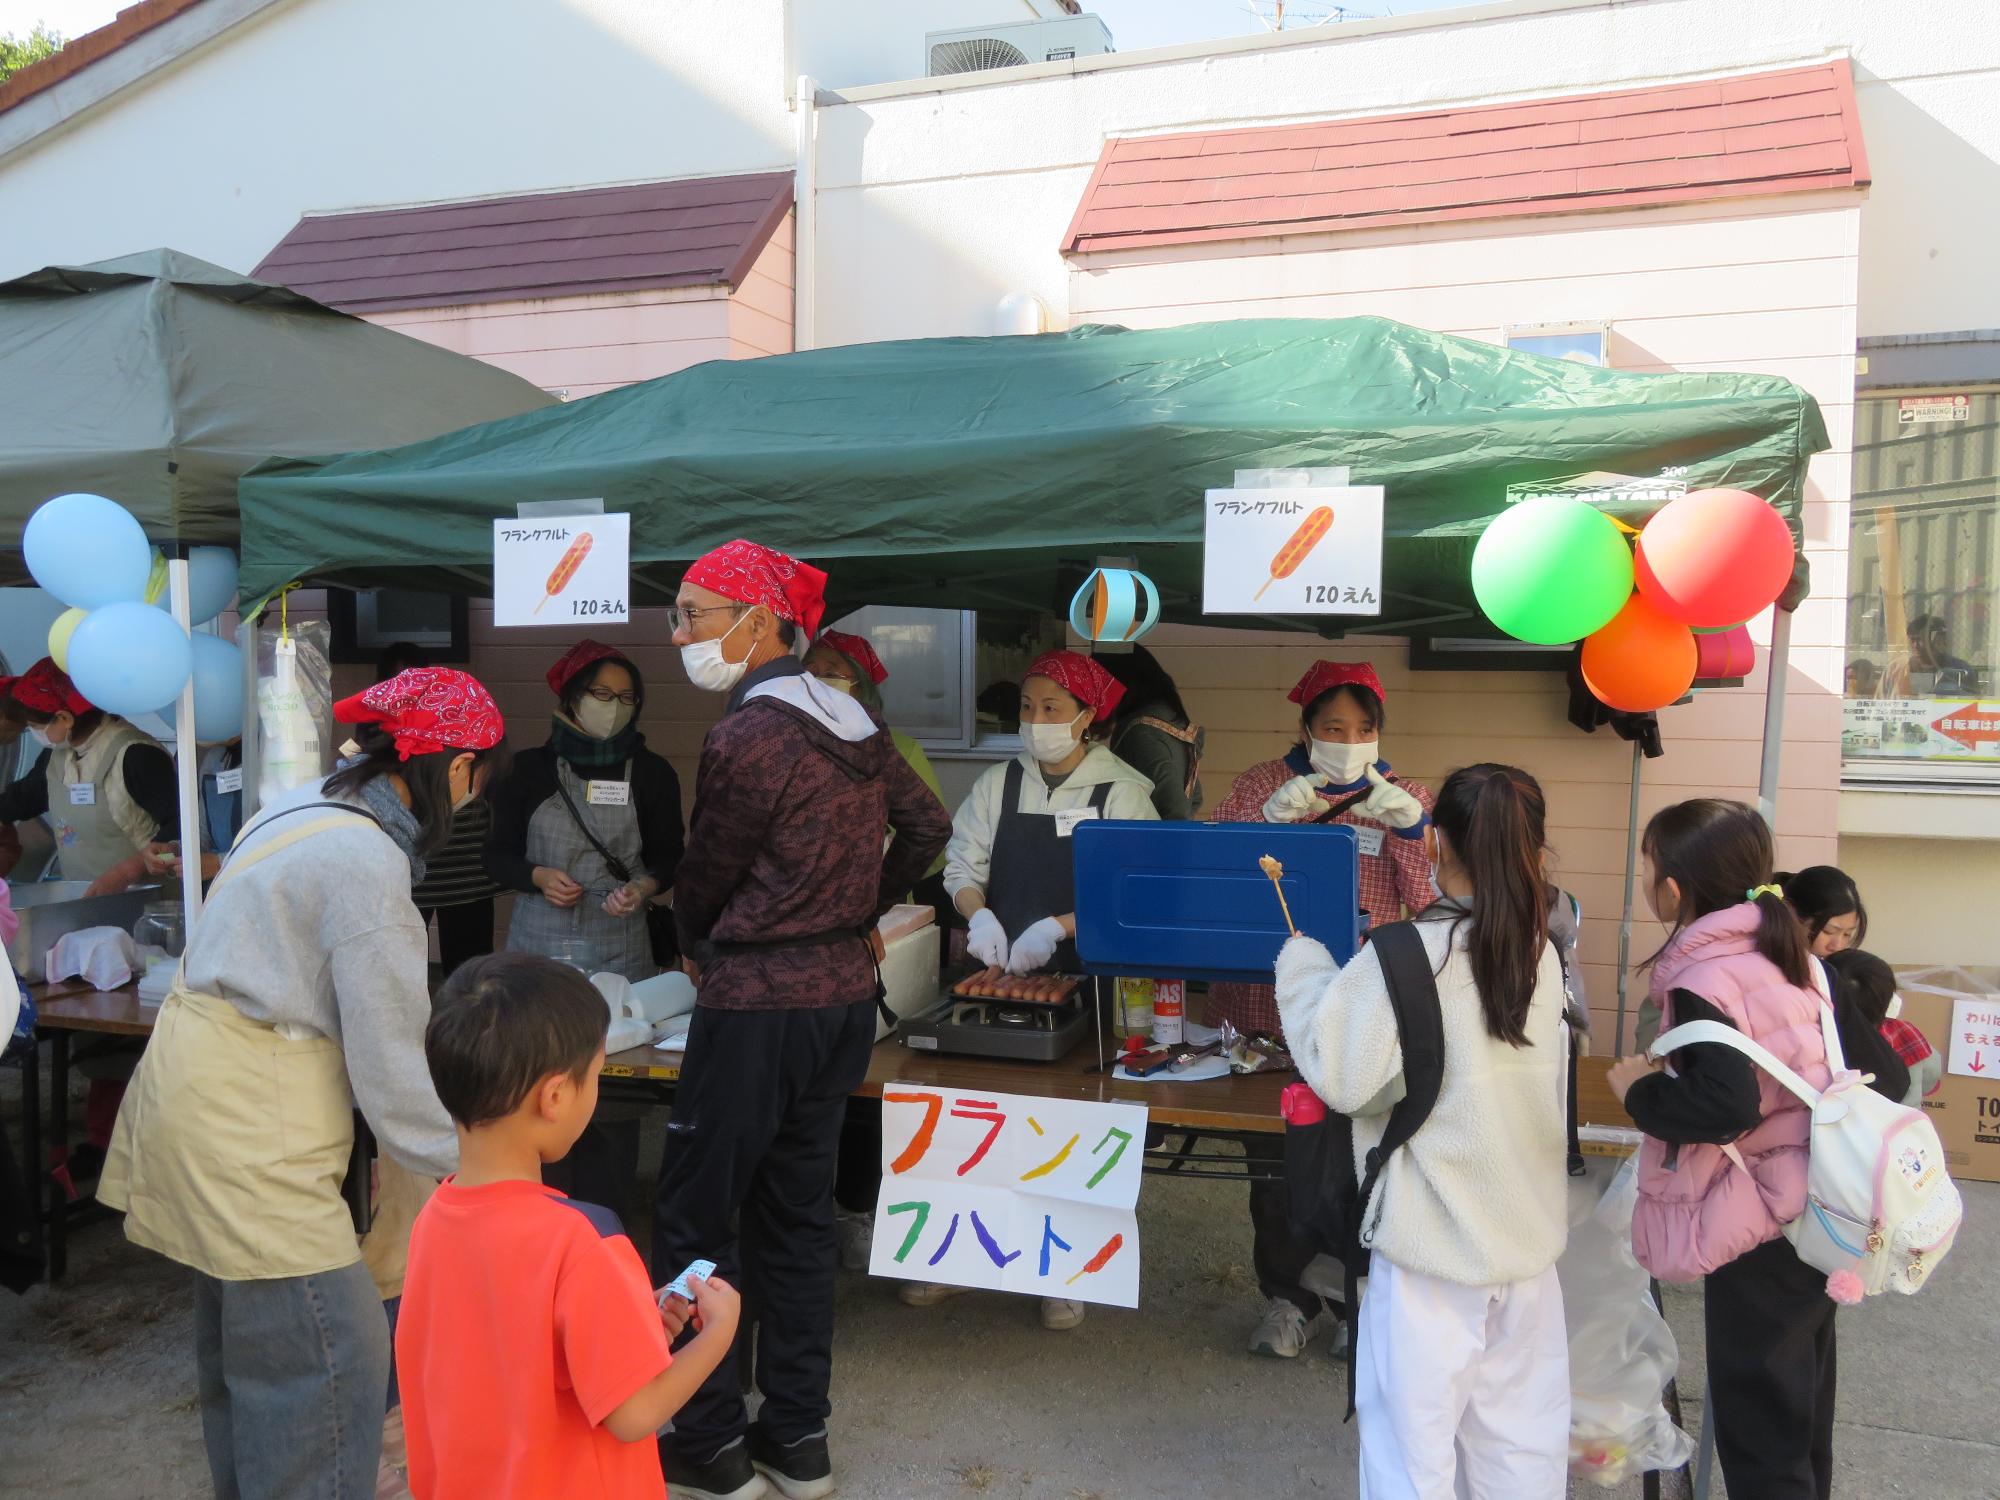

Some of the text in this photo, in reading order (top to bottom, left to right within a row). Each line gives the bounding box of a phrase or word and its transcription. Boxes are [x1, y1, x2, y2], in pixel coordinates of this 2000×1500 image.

[1214, 501, 1304, 515] フランクフルト
[500, 528, 570, 542] フランクフルト
[1305, 585, 1377, 603] 120えん
[572, 599, 626, 615] 120えん
[884, 1092, 1133, 1190] フランク
[887, 1201, 1072, 1276] フルト
